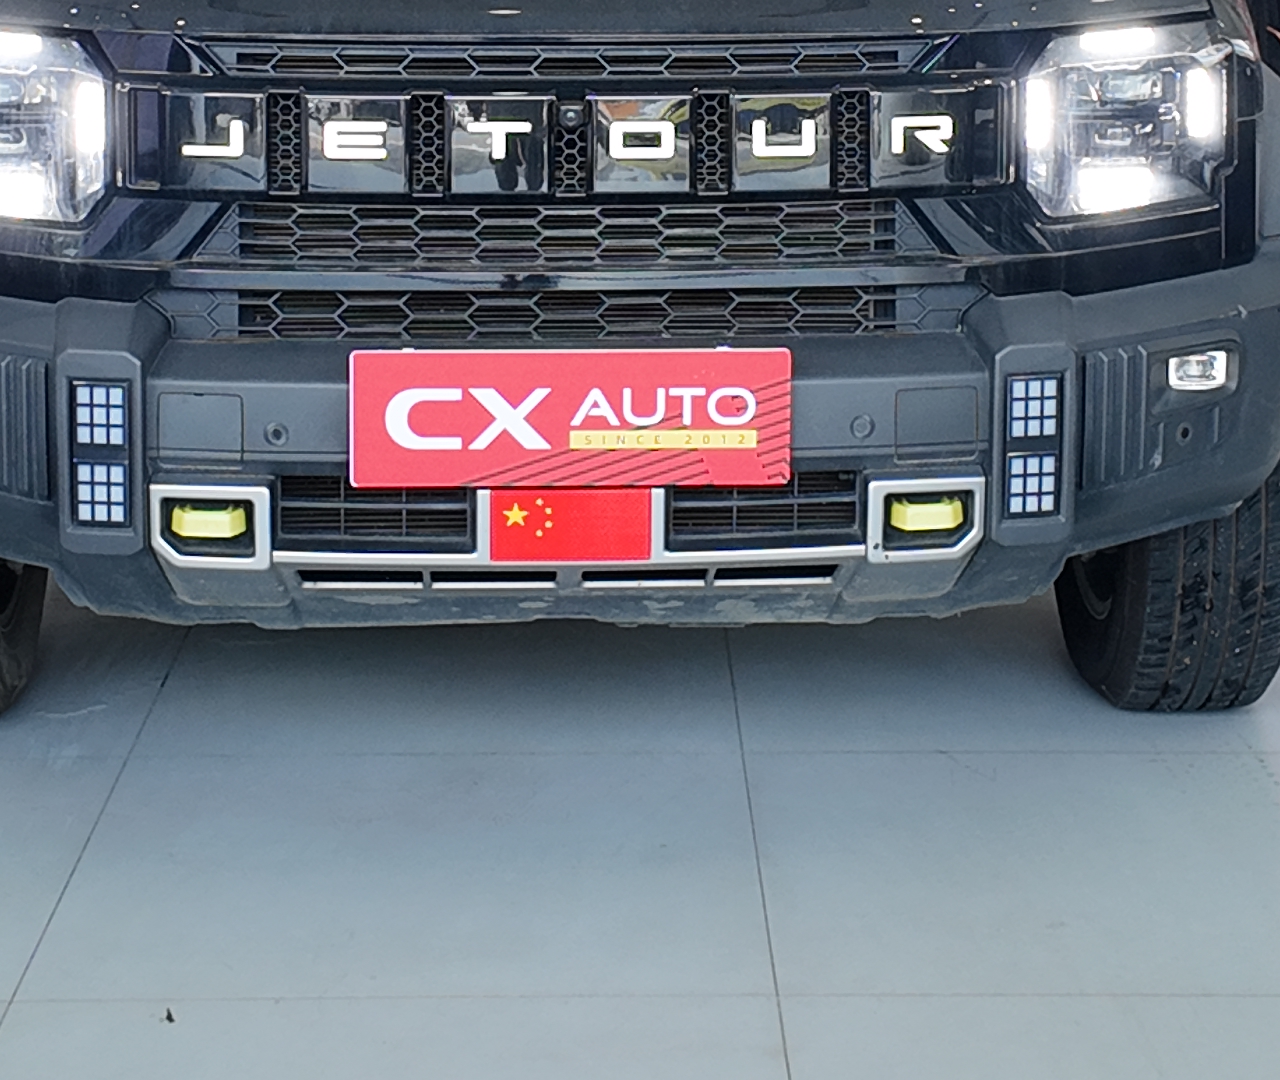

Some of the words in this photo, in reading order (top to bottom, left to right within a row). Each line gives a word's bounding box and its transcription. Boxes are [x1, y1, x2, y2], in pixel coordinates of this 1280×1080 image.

[180, 115, 954, 161] JETOUR
[384, 387, 552, 450] CX
[570, 387, 757, 426] AUTO
[584, 433, 663, 446] SINCE
[683, 432, 747, 446] 2012
